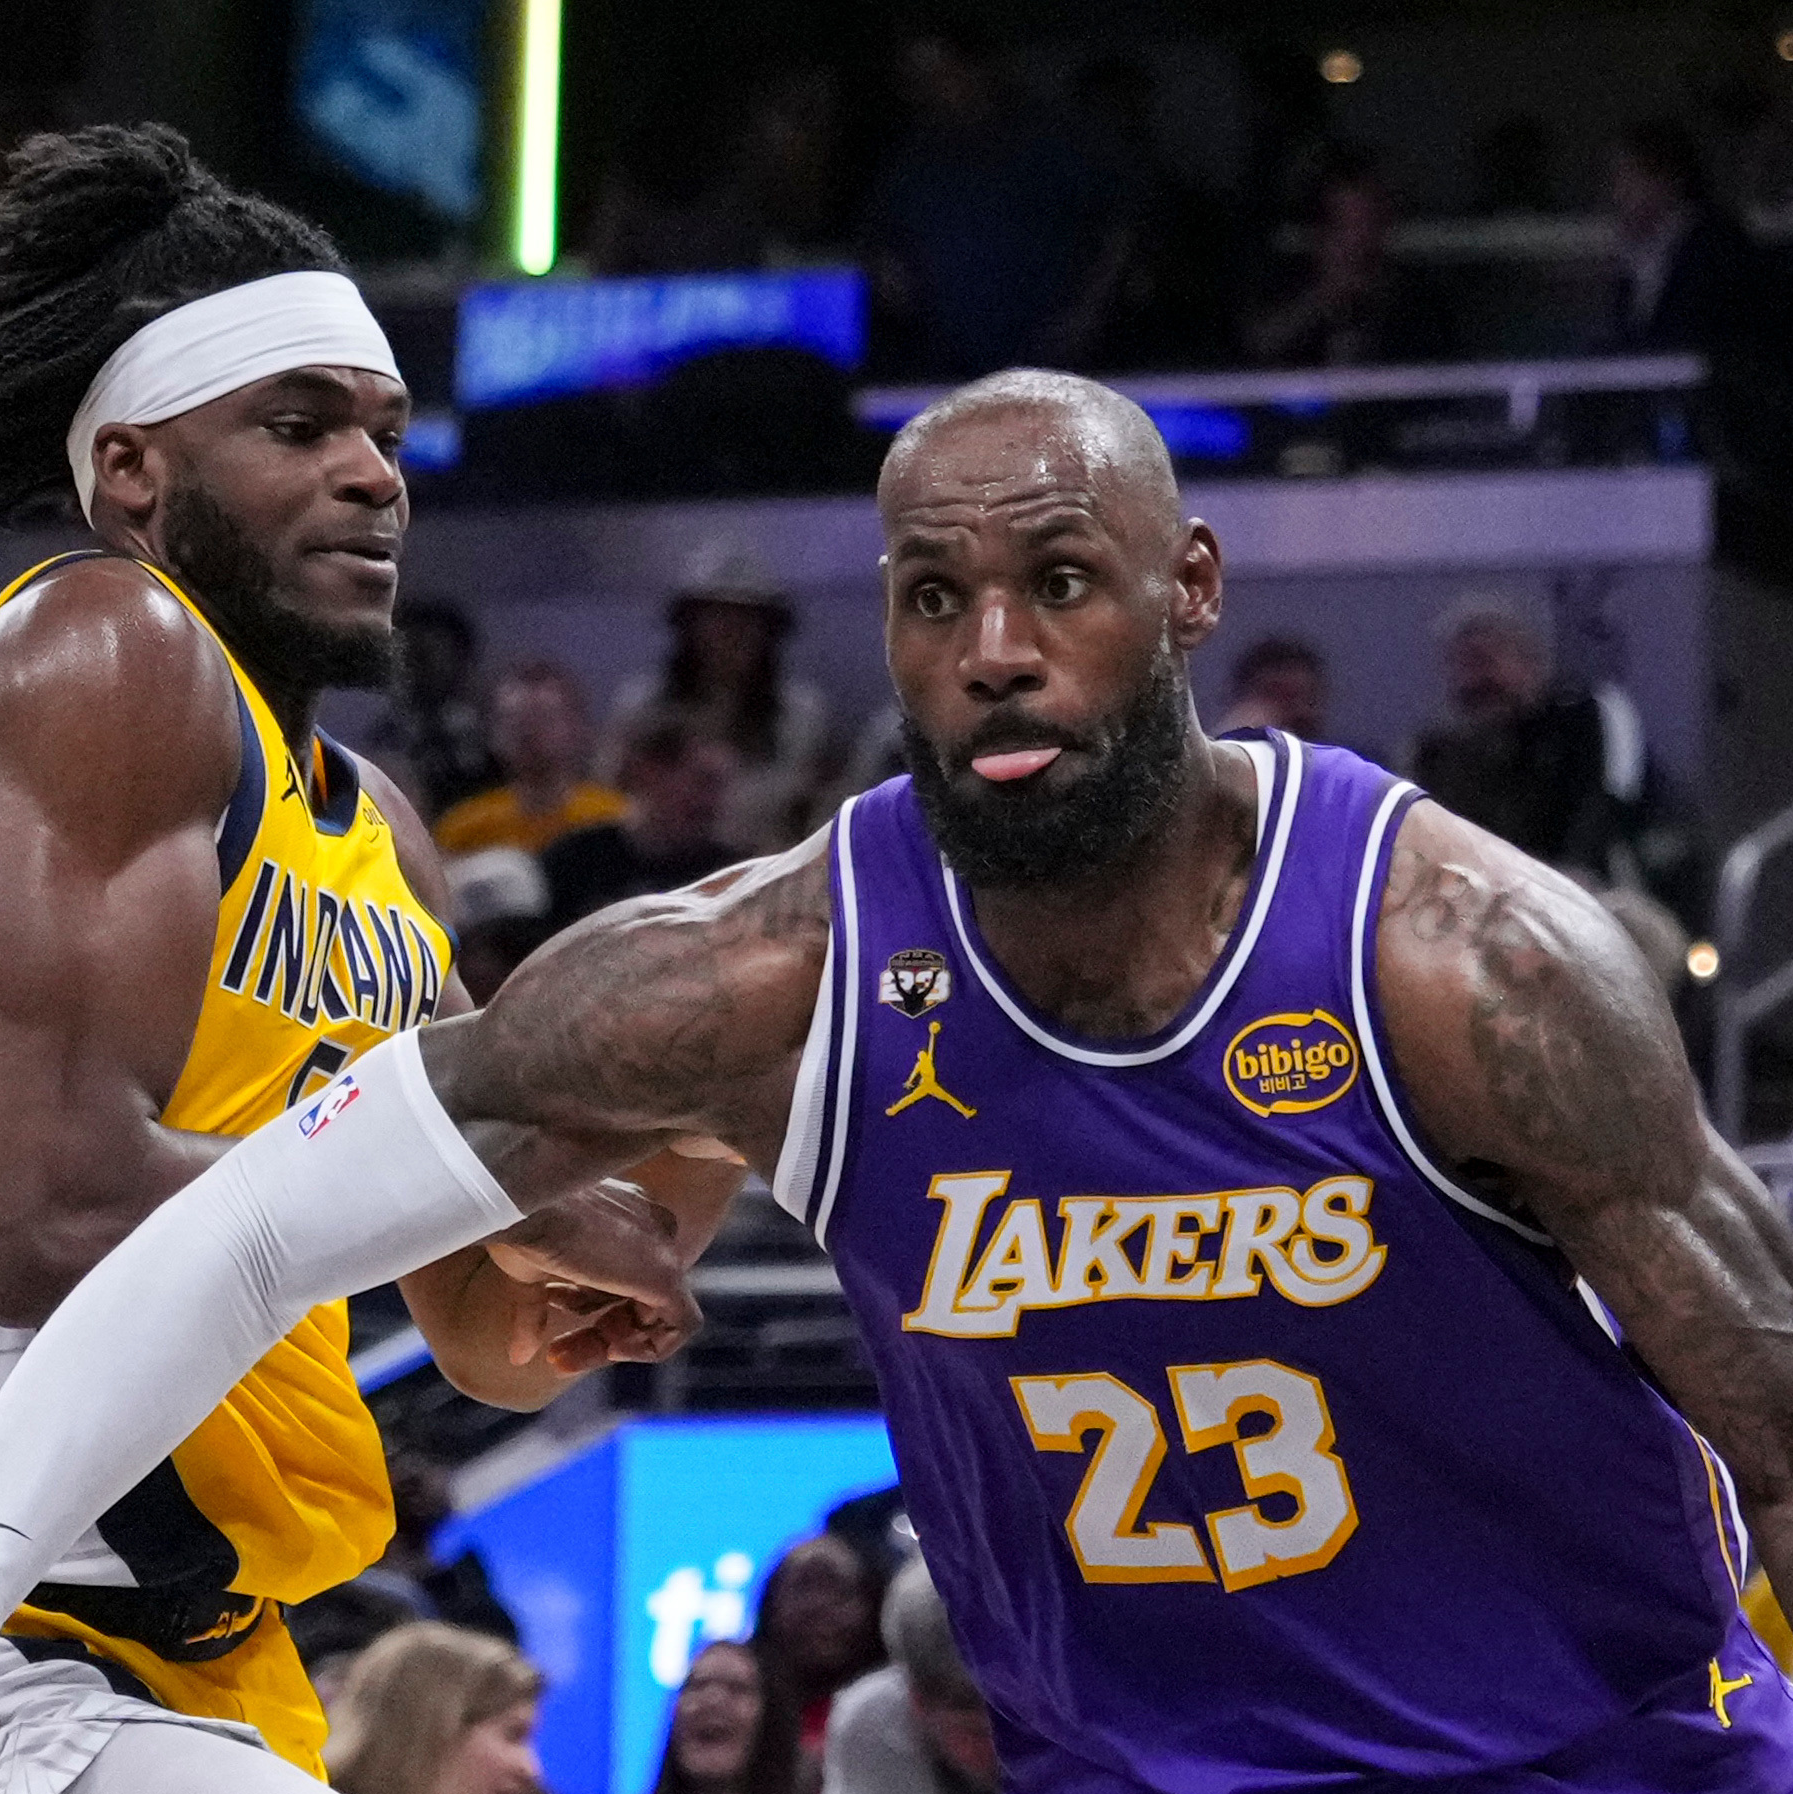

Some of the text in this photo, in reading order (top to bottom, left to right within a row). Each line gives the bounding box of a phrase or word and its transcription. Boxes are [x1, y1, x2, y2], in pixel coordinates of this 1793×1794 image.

[1235, 1038, 1351, 1080] bibigo
[1259, 1073, 1308, 1095] 비비고
[901, 1170, 1389, 1339] LAKERS
[1008, 1358, 1360, 1593] 23
